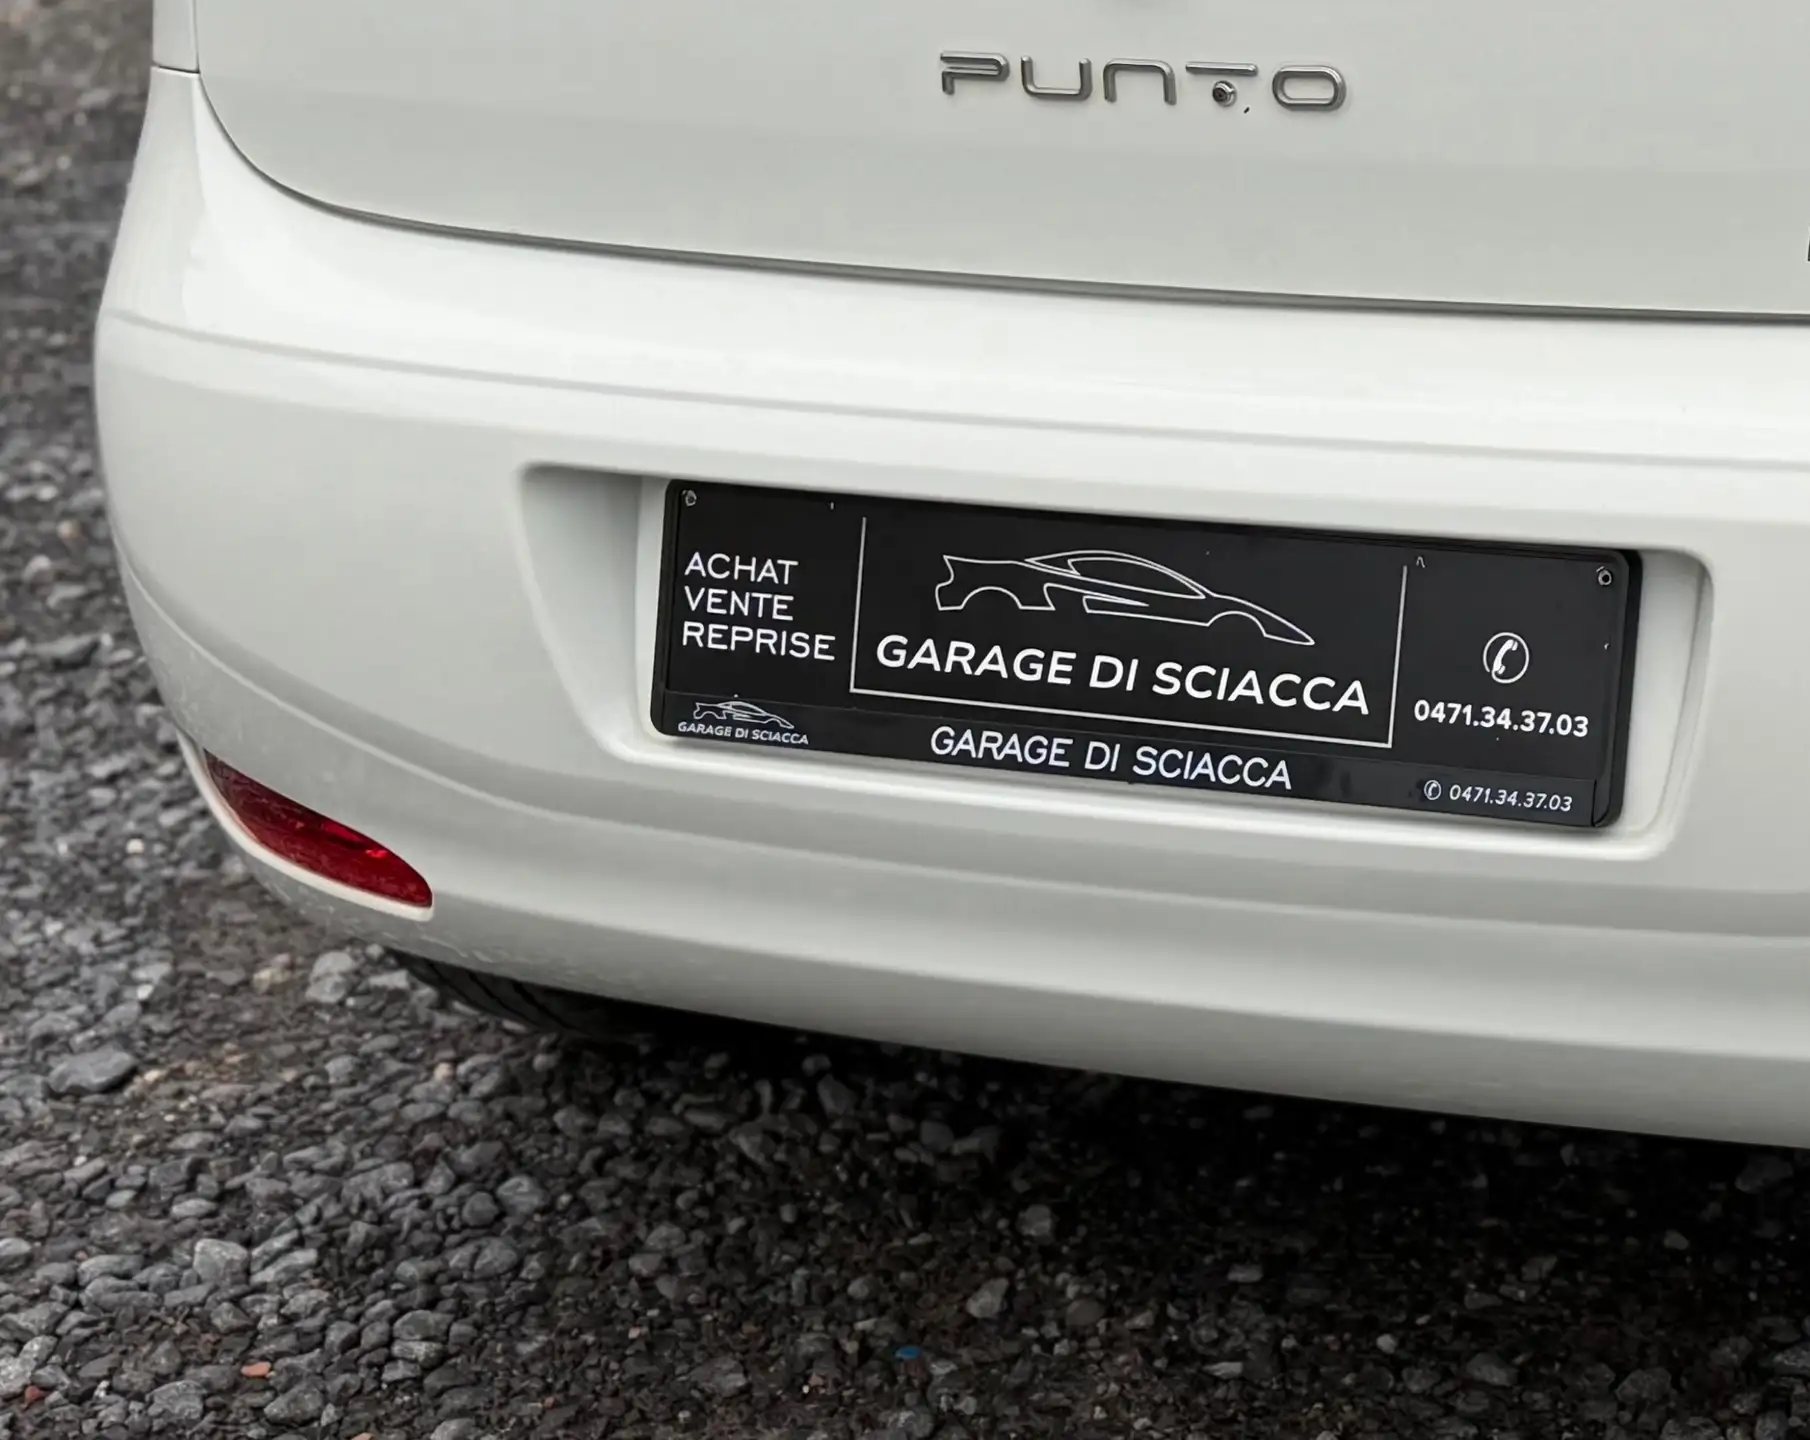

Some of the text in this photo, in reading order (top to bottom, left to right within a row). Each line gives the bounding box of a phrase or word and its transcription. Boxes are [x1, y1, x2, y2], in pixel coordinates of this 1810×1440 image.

[939, 50, 1348, 114] PUNTO
[684, 551, 799, 585] ACHAT
[684, 585, 794, 621] VENTE
[682, 620, 836, 661] REPRISE
[876, 634, 1369, 715] GARAGE DI SCIACCA
[677, 721, 809, 745] GARAGE DI SCIACCA
[1414, 699, 1589, 738] 0471.34.37.03
[930, 726, 1293, 790] GARAGE DI SCIACCA
[1449, 784, 1573, 813] 0471.34.37.03
